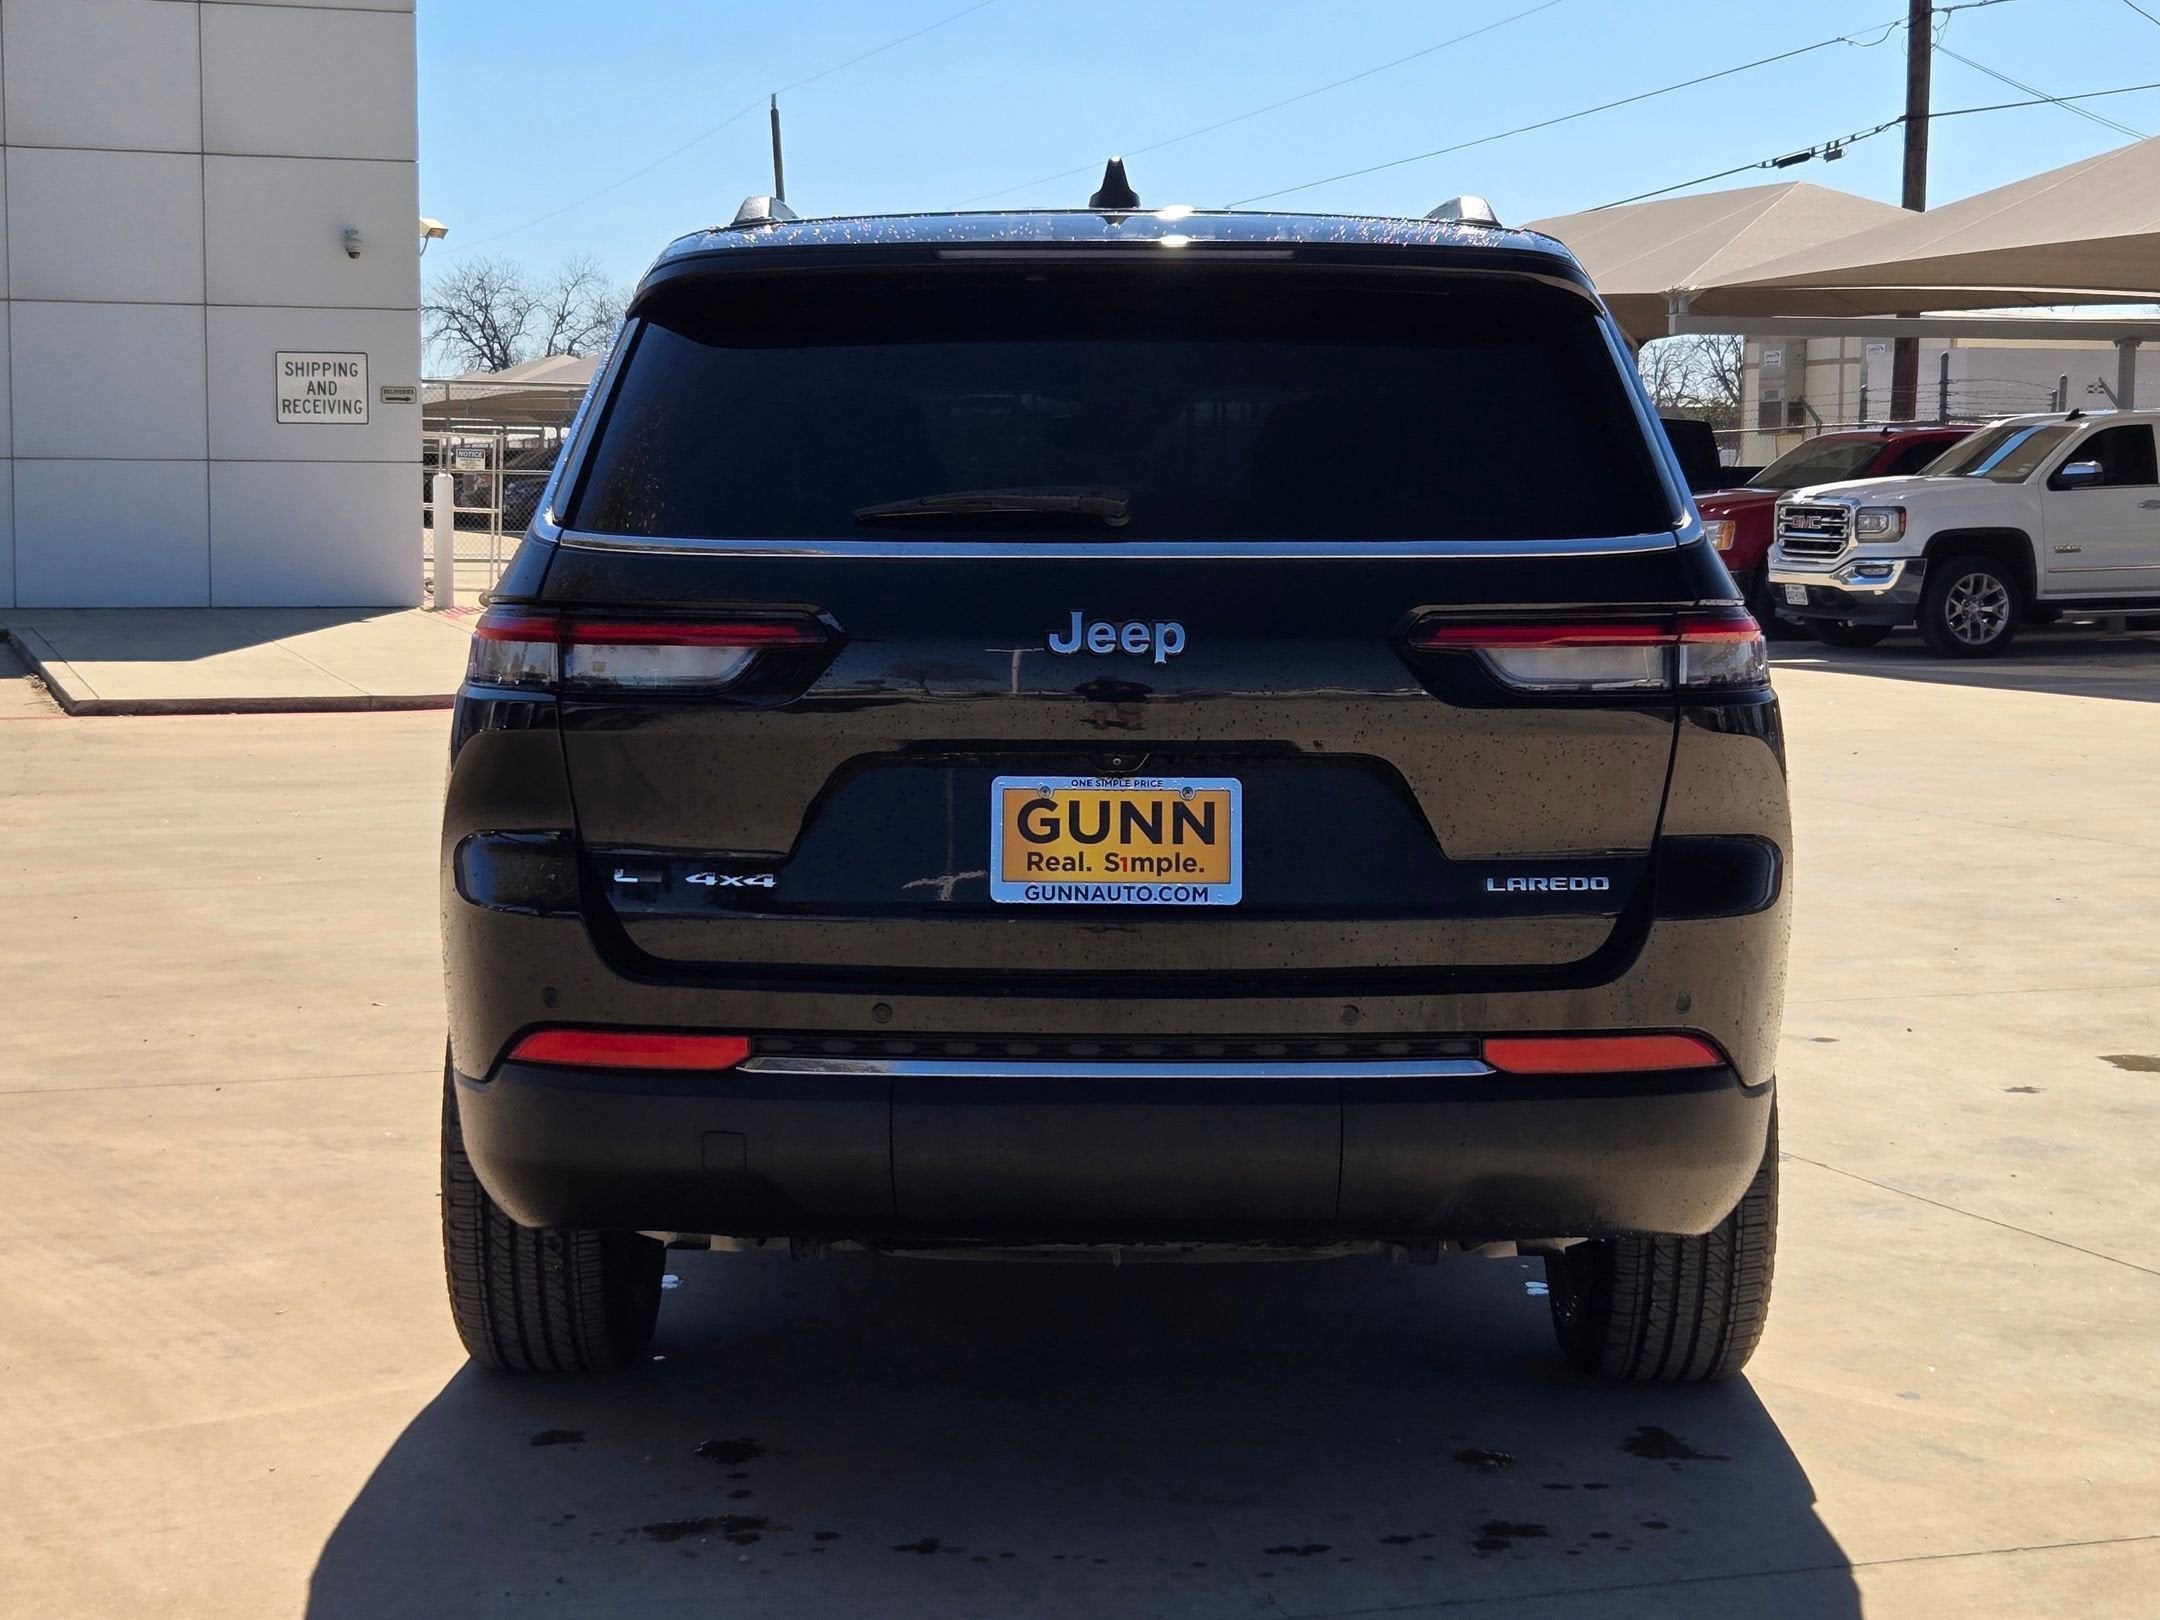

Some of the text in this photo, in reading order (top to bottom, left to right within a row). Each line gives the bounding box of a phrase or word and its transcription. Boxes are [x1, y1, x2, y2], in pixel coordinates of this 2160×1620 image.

[284, 361, 359, 378] SHIPPING
[306, 380, 338, 396] AND
[282, 399, 363, 415] RECEIVING
[457, 450, 484, 458] NOTICE
[1791, 515, 1821, 529] GMC
[1048, 610, 1186, 664] Jeep
[1071, 778, 1163, 788] ONE SIMPLE PRICE
[1017, 798, 1216, 845] GUNN
[1026, 851, 1093, 872] Real.
[1486, 876, 1610, 892] LAREDO
[1024, 885, 1209, 902] GUNNAUTO.COM
